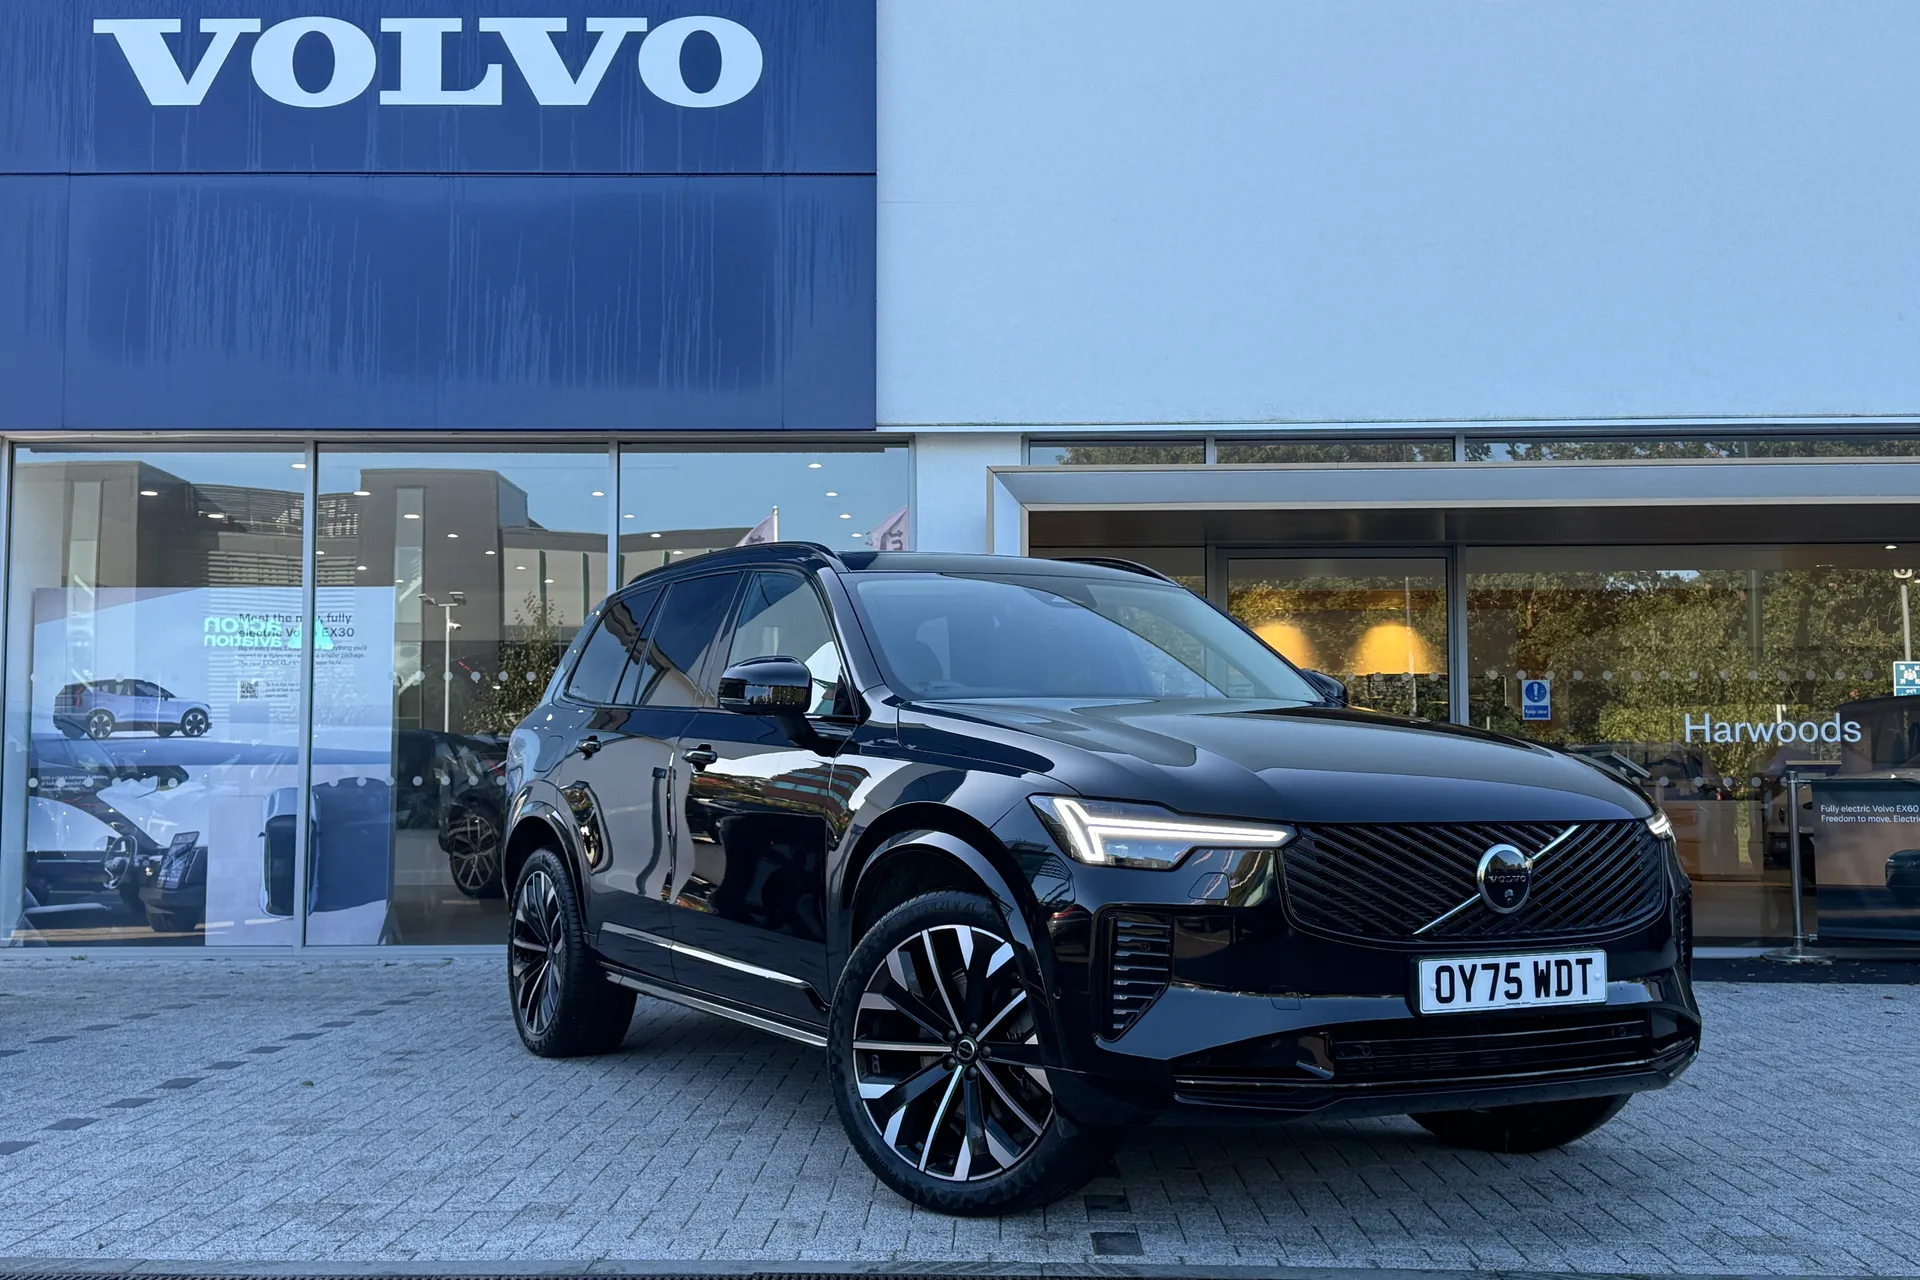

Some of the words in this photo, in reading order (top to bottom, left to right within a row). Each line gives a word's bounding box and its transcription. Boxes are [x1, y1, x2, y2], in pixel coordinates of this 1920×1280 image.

[93, 15, 763, 108] VOLVO
[239, 613, 270, 622] Meet
[273, 613, 292, 622] the
[326, 612, 352, 624] fully
[239, 627, 282, 637] electric
[322, 627, 354, 637] EX30
[1684, 712, 1862, 743] Harwoods
[1820, 804, 1840, 814] Fully
[1841, 804, 1871, 813] electric
[1872, 804, 1895, 813] Volvo
[1896, 804, 1920, 813] EX60
[1821, 815, 1856, 823] Freedom
[1857, 815, 1867, 823] to
[1893, 814, 1920, 823] Electri
[1488, 875, 1526, 883] VOLVO
[1435, 961, 1523, 1004] OY75
[1532, 957, 1593, 999] WDT
